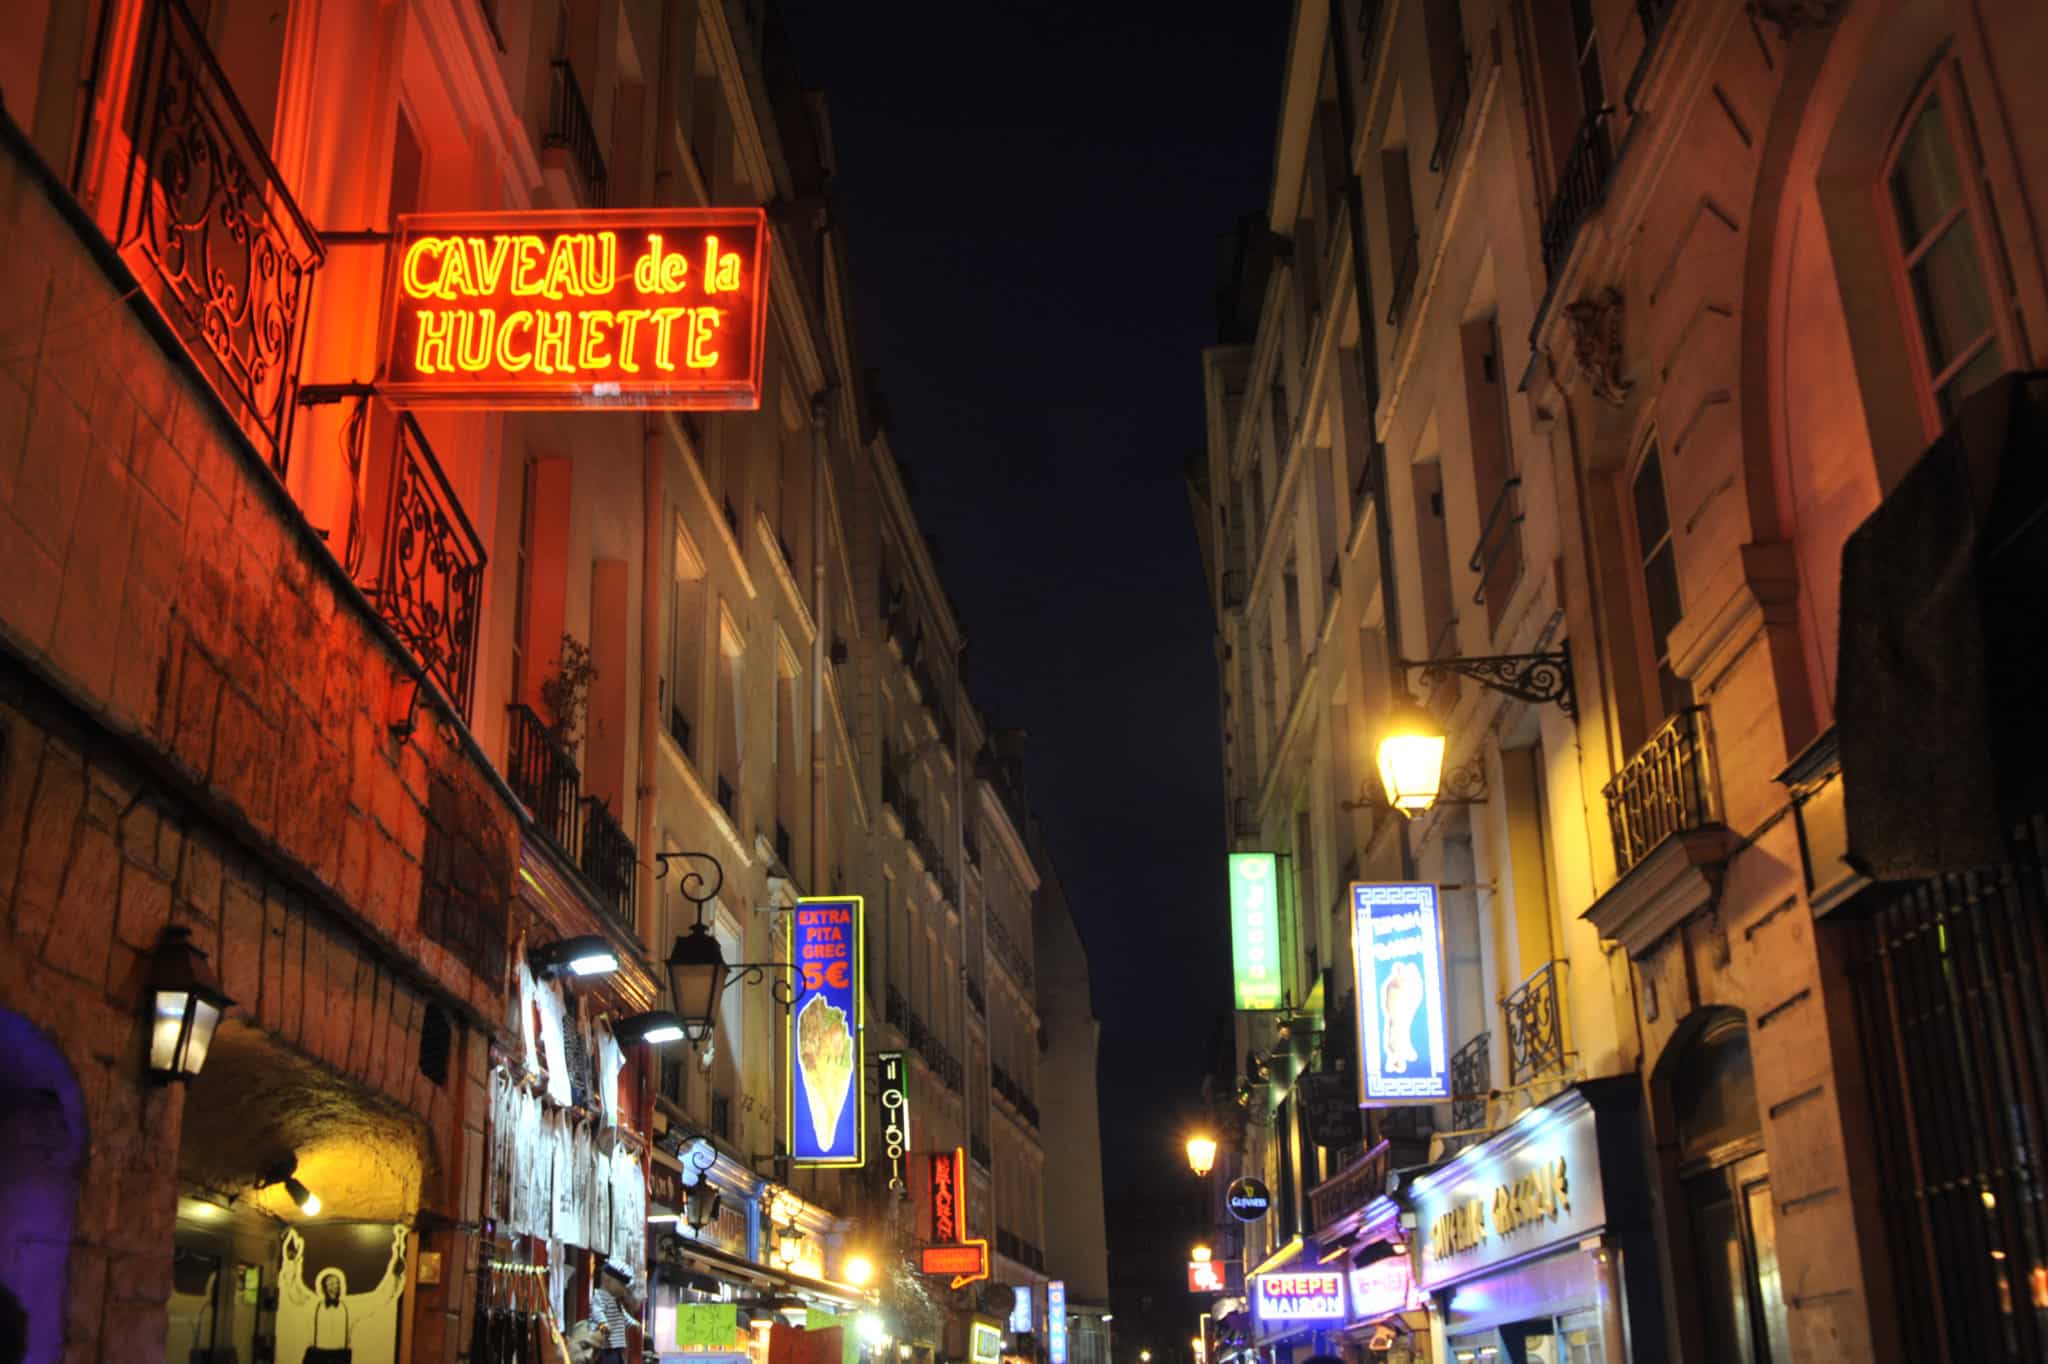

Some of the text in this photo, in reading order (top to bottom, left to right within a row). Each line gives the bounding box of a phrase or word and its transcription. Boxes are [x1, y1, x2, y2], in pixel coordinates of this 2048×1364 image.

[403, 232, 742, 300] CAVEAU de la
[416, 306, 721, 374] HUCHETTE
[799, 909, 851, 925] EXTRA
[807, 927, 842, 942] PITA
[803, 943, 846, 959] GREC
[802, 960, 849, 990] 5€
[1266, 1278, 1336, 1296] CREPE
[1262, 1297, 1340, 1313] MAISON
